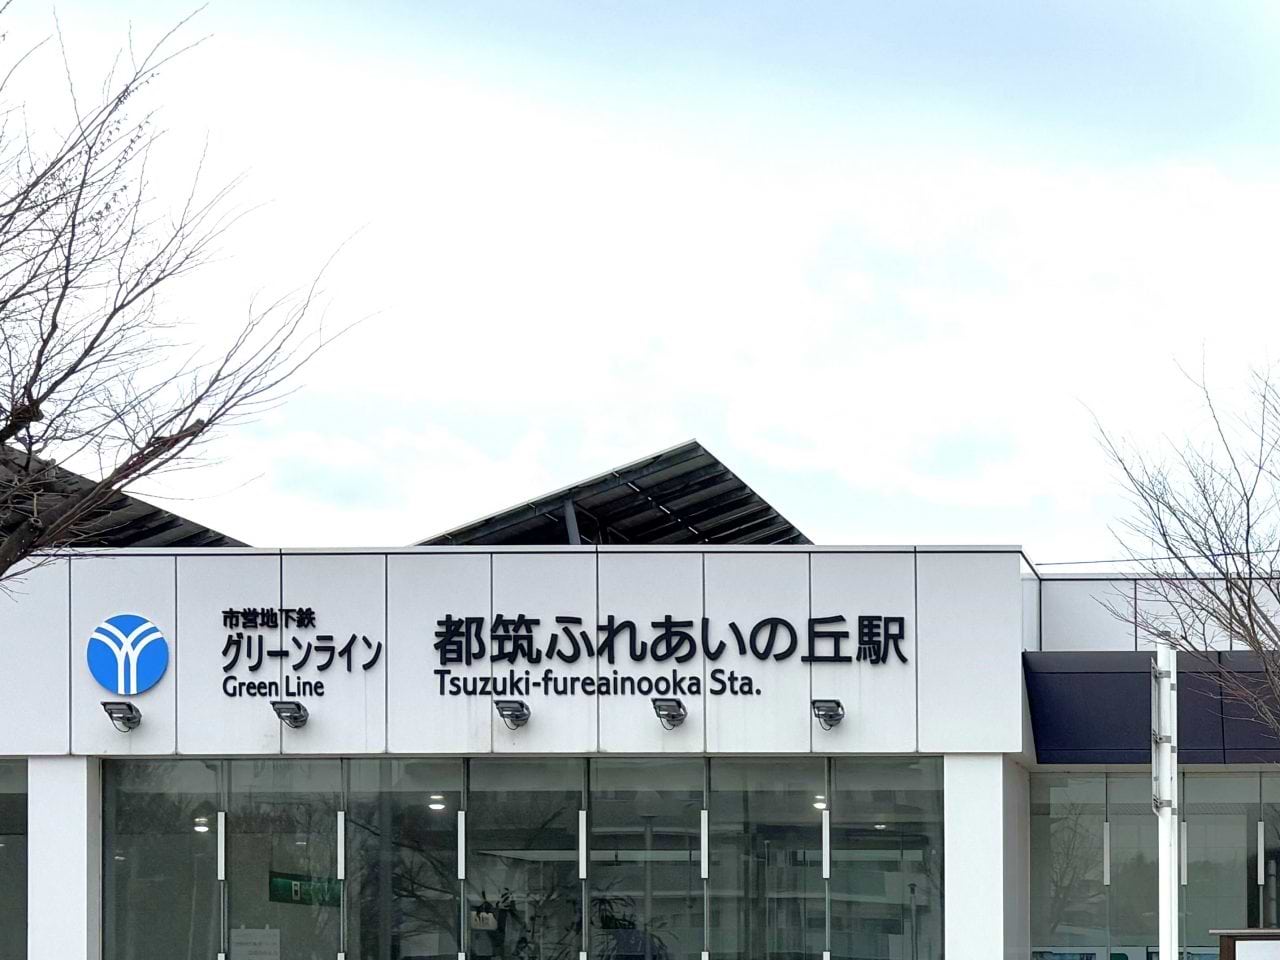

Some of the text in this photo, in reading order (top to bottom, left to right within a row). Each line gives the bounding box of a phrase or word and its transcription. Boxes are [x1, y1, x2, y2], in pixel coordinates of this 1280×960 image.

[222, 607, 316, 629] 市営地下鉄
[221, 632, 383, 673] グリーンライン
[433, 613, 909, 666] 都筑ふれあいの丘駅
[222, 675, 325, 698] Green Line
[433, 668, 762, 696] Tsuzuki-fureainooka Sta.
